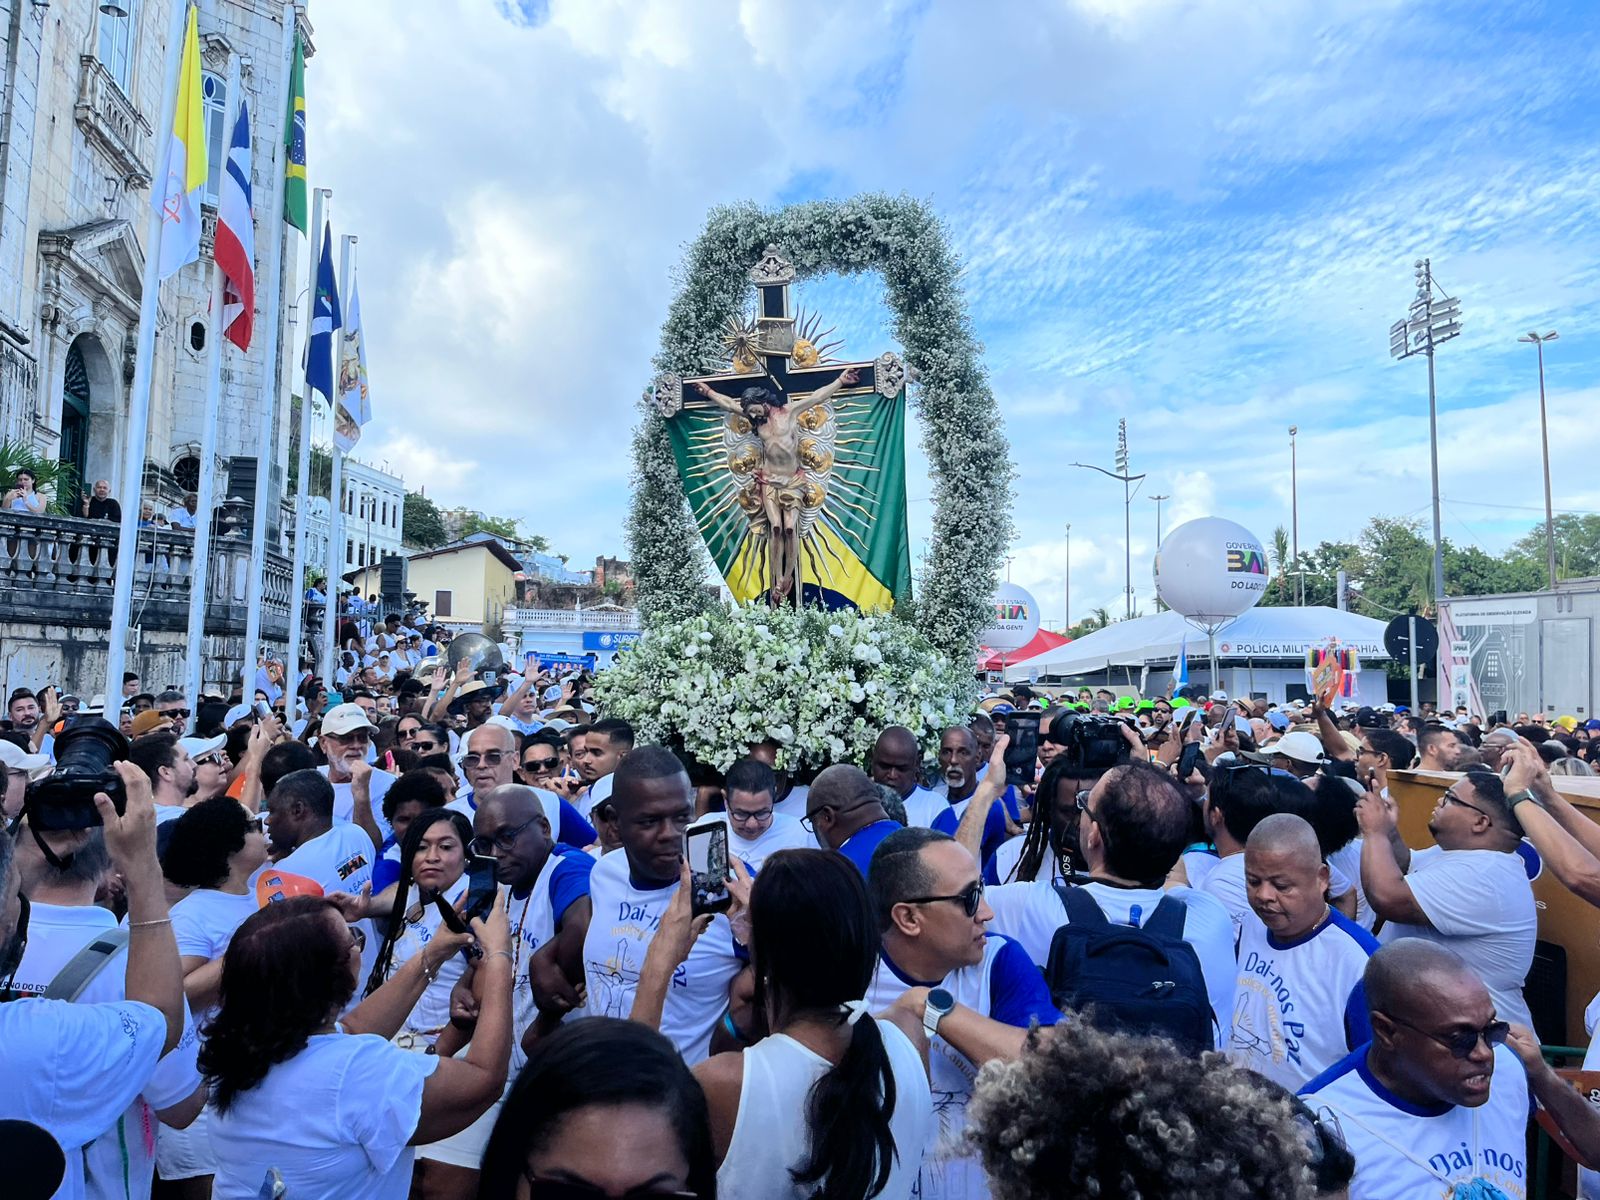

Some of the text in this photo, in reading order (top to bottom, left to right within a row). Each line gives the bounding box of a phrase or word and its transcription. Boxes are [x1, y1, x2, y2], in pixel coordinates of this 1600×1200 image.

[1231, 581, 1244, 589] DO
[1236, 641, 1279, 654] POLÍCIA
[1062, 854, 1072, 876] SON
[619, 901, 661, 931] Dai-n
[22, 983, 34, 991] DO
[1244, 952, 1295, 1015] Dai-nos
[1282, 1020, 1305, 1066] Paz
